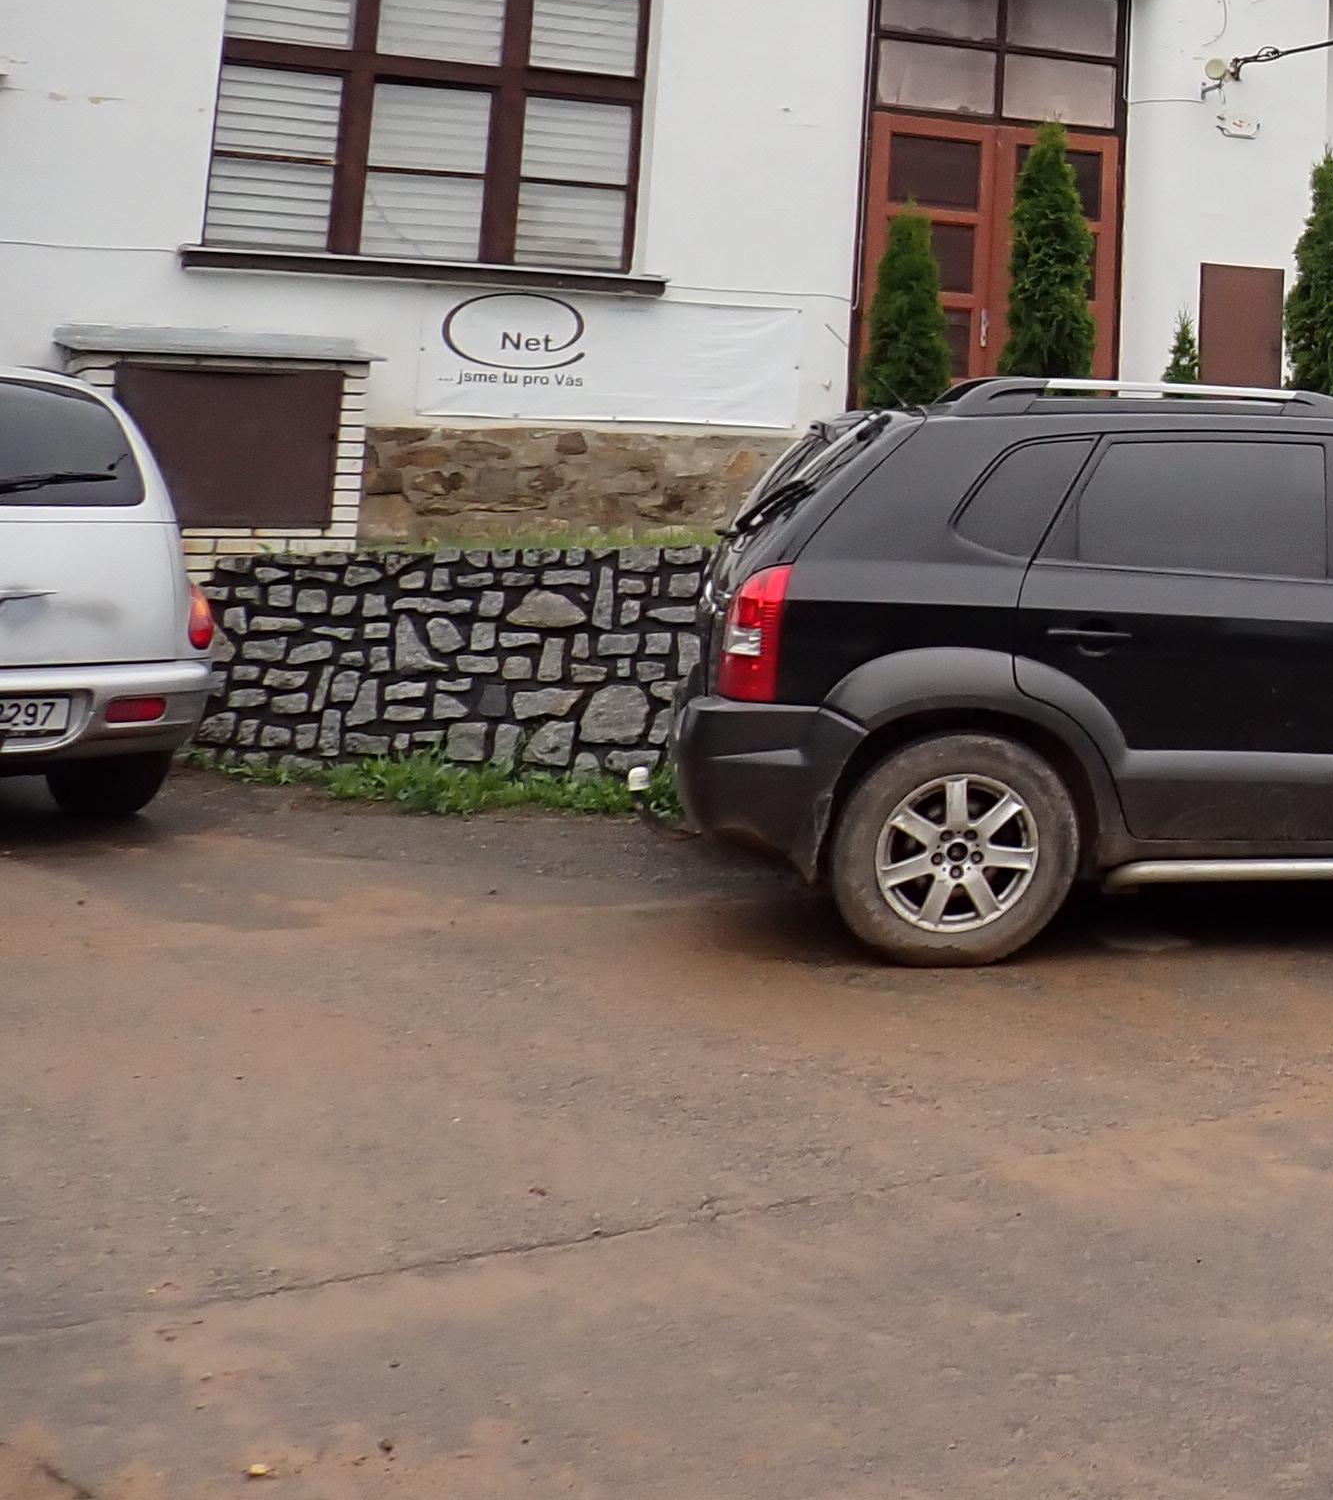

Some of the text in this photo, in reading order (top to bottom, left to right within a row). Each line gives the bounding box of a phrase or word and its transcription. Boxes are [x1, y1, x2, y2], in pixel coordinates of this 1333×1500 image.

[500, 331, 554, 353] Net
[457, 369, 498, 385] jsme
[503, 371, 518, 385] tu
[522, 375, 550, 388] pro
[554, 371, 583, 388] Vás
